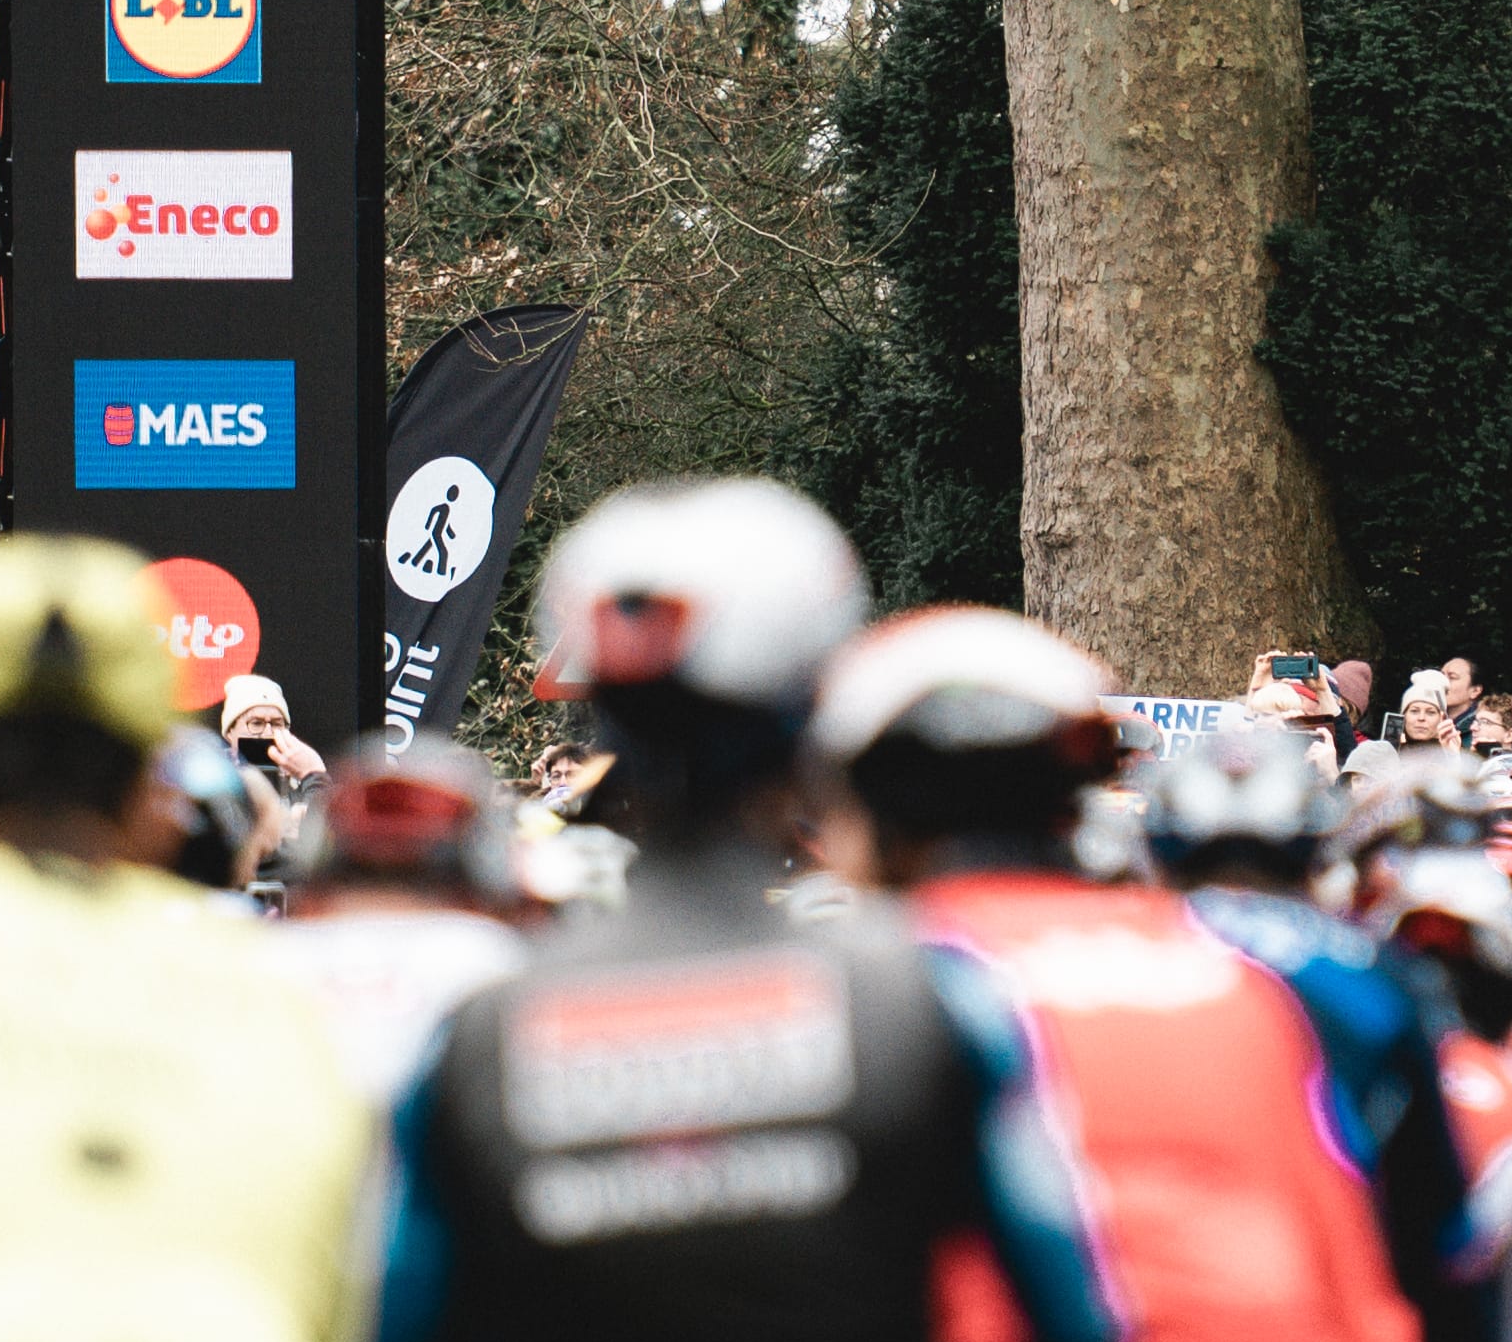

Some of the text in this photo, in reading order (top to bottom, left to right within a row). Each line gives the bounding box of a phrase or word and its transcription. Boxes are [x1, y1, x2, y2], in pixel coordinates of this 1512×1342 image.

[127, 195, 279, 236] Eneco
[139, 404, 267, 446] MAES
[385, 641, 440, 765] oint
